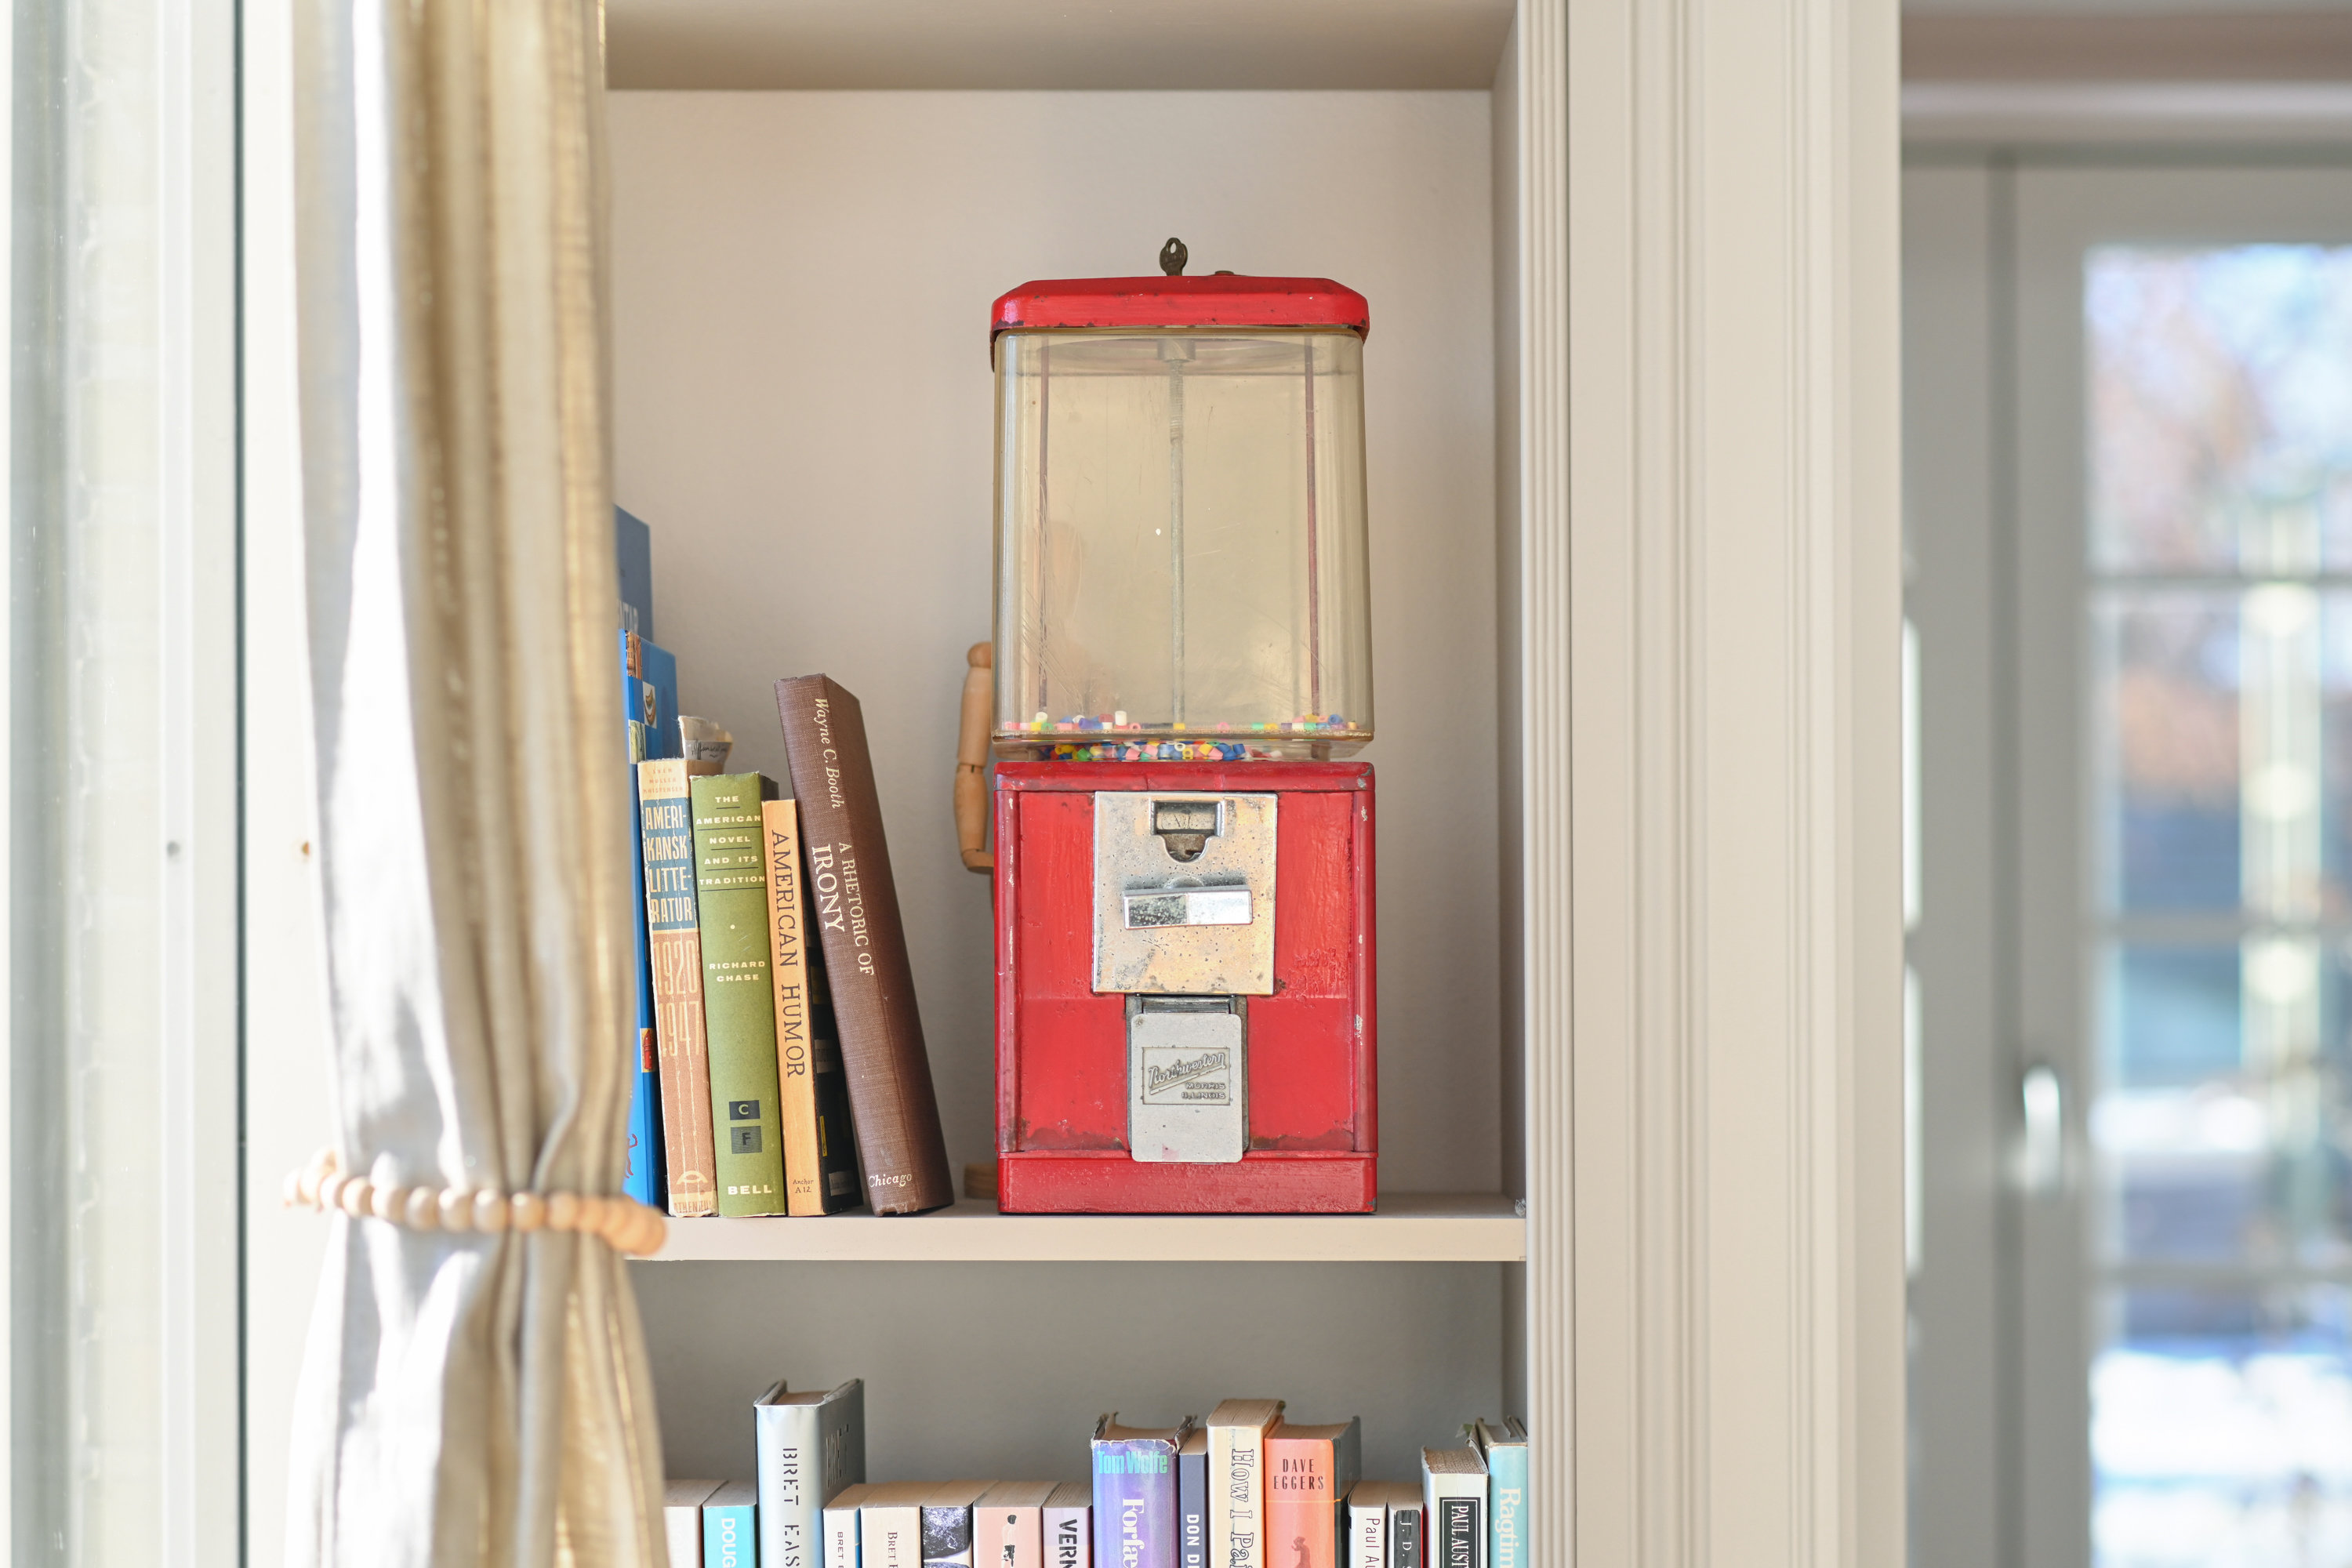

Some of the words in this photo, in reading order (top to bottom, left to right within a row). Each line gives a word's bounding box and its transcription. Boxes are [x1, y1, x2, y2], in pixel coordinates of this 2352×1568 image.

[814, 699, 830, 744] Wayne
[823, 749, 837, 764] C.
[826, 767, 845, 809] Booth
[645, 805, 687, 829] AMERI-
[695, 815, 761, 825] AMERICAN
[647, 835, 688, 862] KANSK
[838, 842, 852, 854] A
[649, 866, 691, 893] LITTE-
[699, 876, 765, 885] TRADITION
[811, 844, 845, 932] IRONY
[651, 896, 693, 924] RATUR
[772, 829, 798, 967] AMERICAN
[841, 858, 869, 947] RHETORIC
[654, 940, 698, 996] 1920
[709, 960, 765, 970] RICHARD
[858, 953, 874, 975] OF
[717, 974, 759, 982] CHASE
[658, 1000, 700, 1057] 1947
[781, 983, 806, 1078] HUMOR
[1149, 1052, 1225, 1088] Northwestern
[739, 1104, 749, 1115] C
[742, 1132, 751, 1145] F
[728, 1185, 771, 1195] BELL
[868, 1174, 913, 1188] Chicago
[1098, 1451, 1125, 1474] Tom
[1126, 1450, 1168, 1474] Wolfe
[1283, 1458, 1315, 1473] DAVE
[782, 1448, 799, 1505] BRET
[1230, 1449, 1254, 1502] How
[1273, 1475, 1324, 1490] EGGERS
[1229, 1510, 1253, 1519] I
[1399, 1521, 1412, 1532] J.
[1451, 1505, 1469, 1535] PAUL
[1186, 1514, 1200, 1546] DON
[1365, 1518, 1380, 1548] Paul
[720, 1518, 737, 1568] DOUG
[1402, 1542, 1412, 1556] D.
